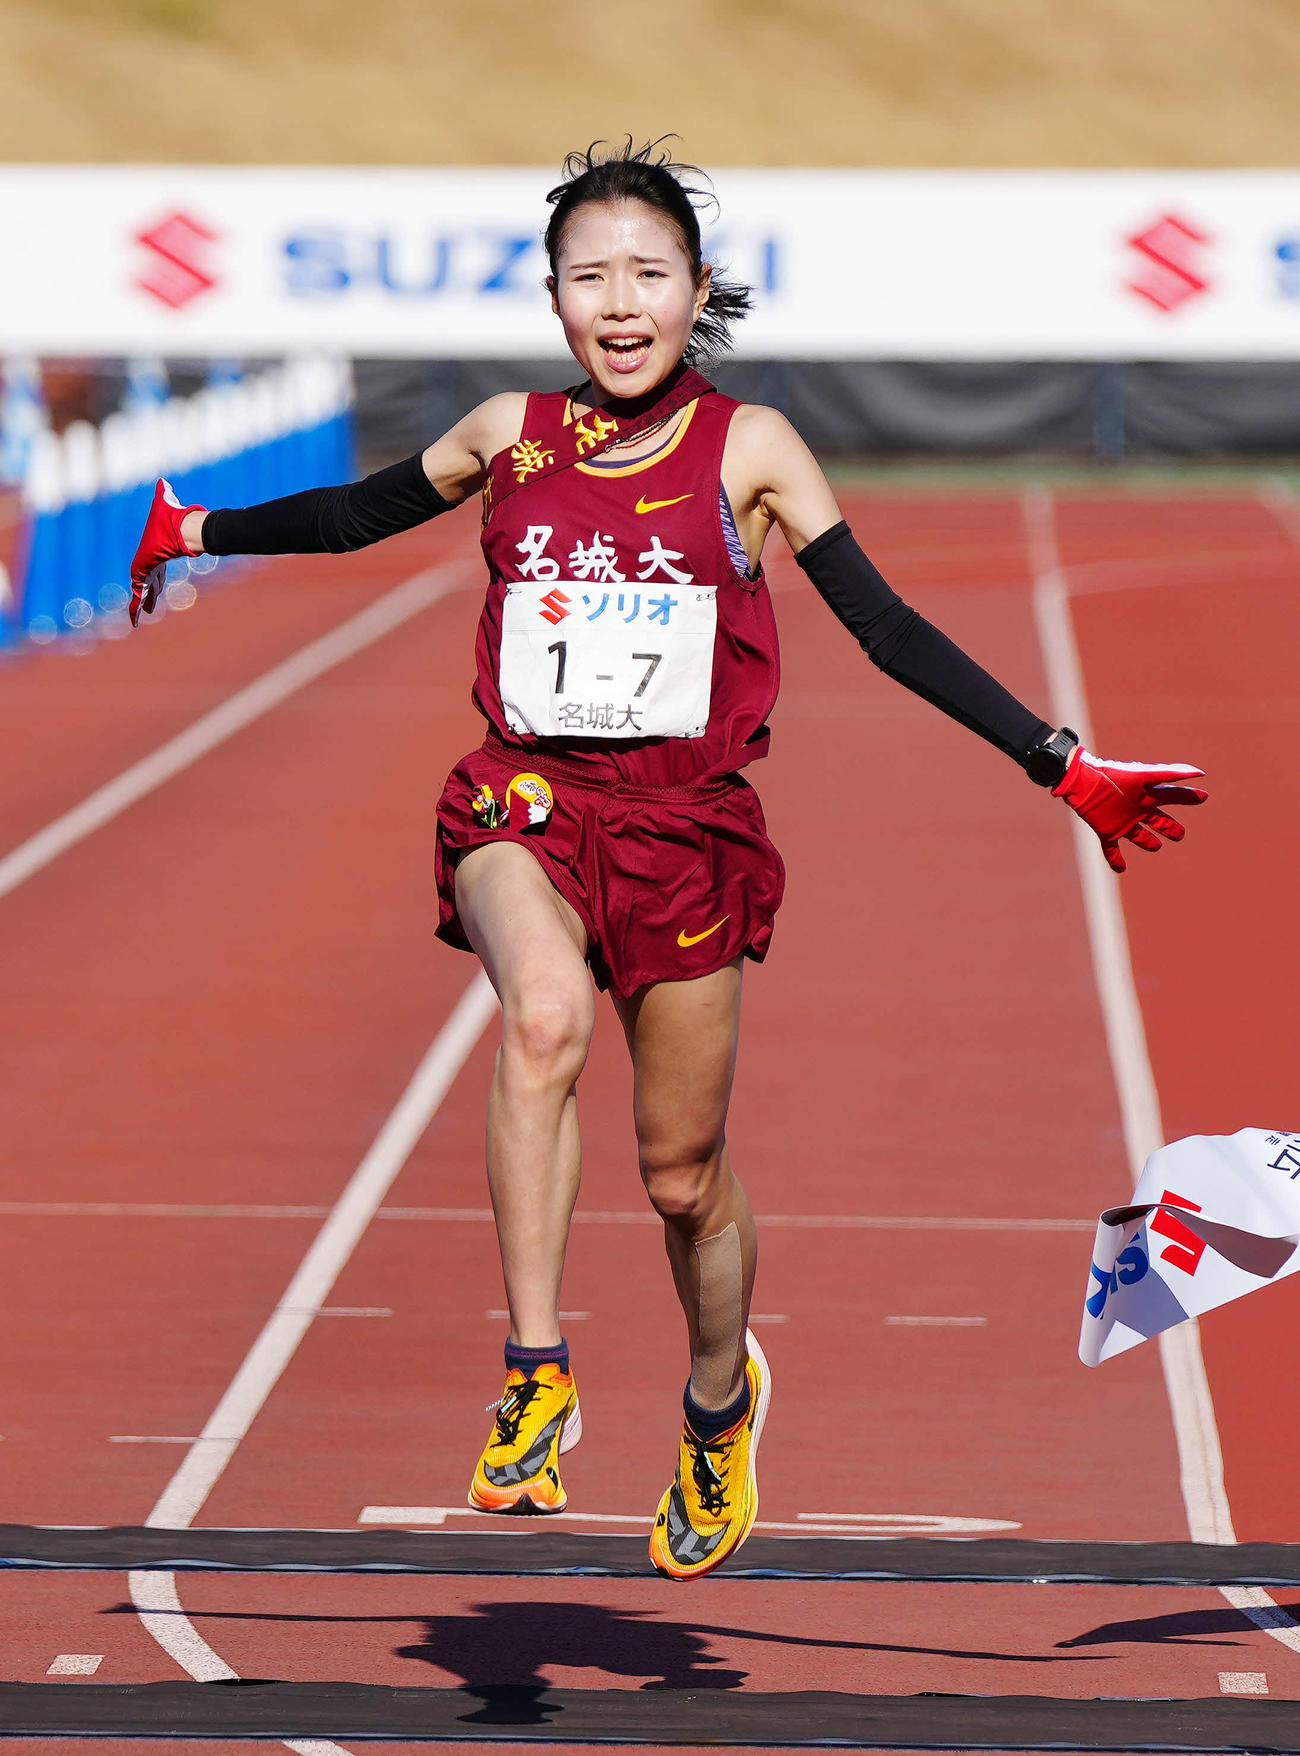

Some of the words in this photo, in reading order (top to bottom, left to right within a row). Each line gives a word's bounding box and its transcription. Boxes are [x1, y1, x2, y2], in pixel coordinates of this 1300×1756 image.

[281, 233, 786, 296] SUZI
[515, 525, 695, 585] 名城大
[582, 593, 678, 626] ソリオ
[558, 702, 644, 731] 名城大
